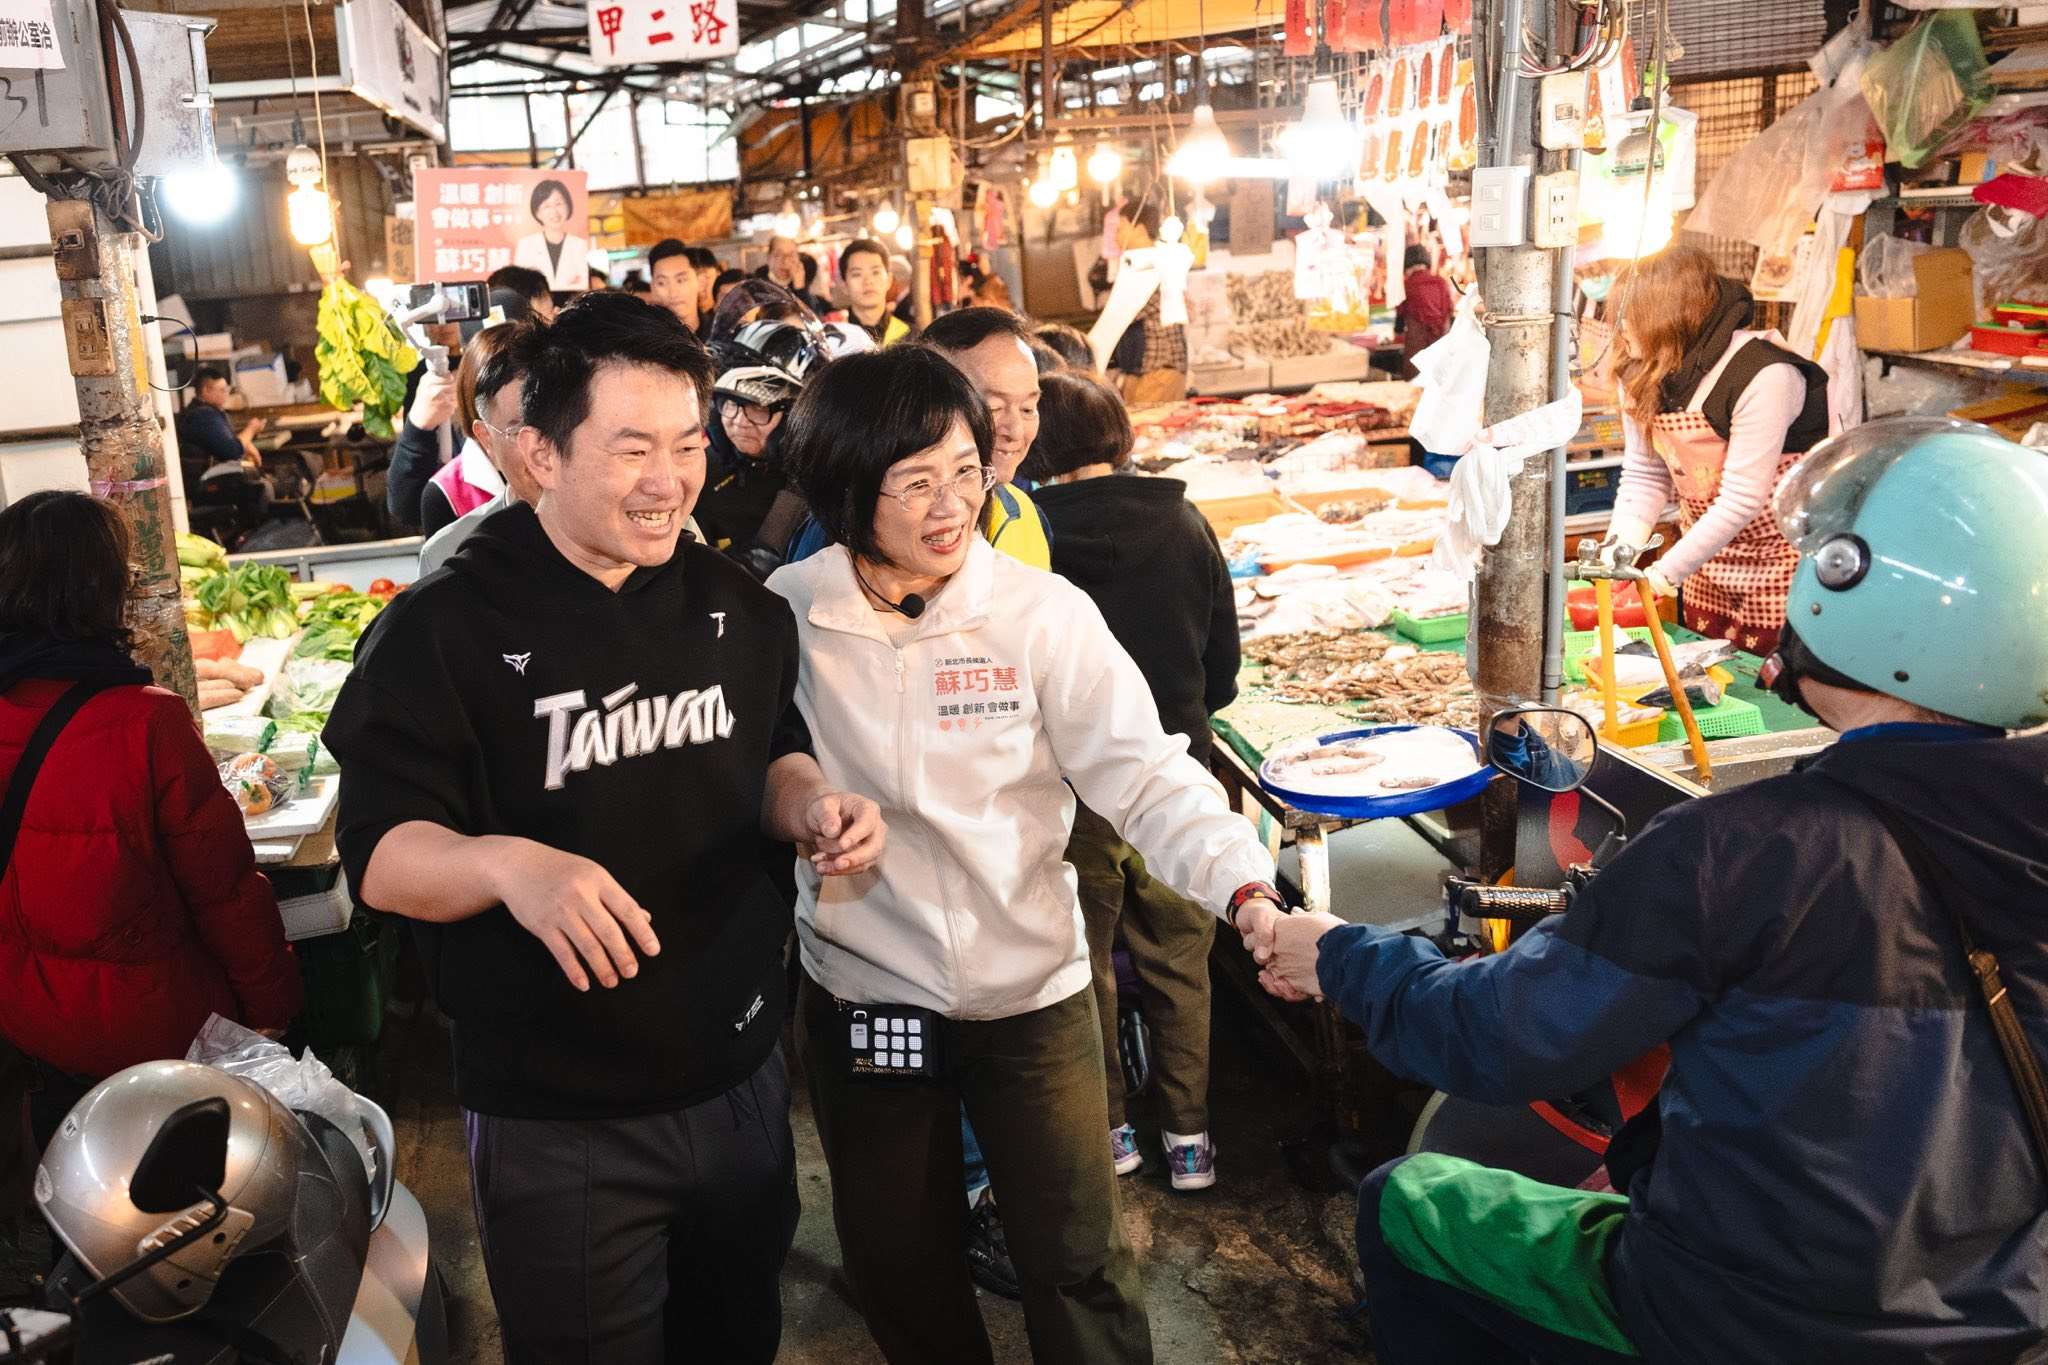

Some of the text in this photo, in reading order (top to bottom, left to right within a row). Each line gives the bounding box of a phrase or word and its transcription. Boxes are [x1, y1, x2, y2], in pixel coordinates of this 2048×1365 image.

[597, 0, 729, 55] 甲二路
[934, 666, 1019, 696] 蘇巧慧
[962, 702, 985, 715] 創新
[987, 701, 1020, 713] 會做事
